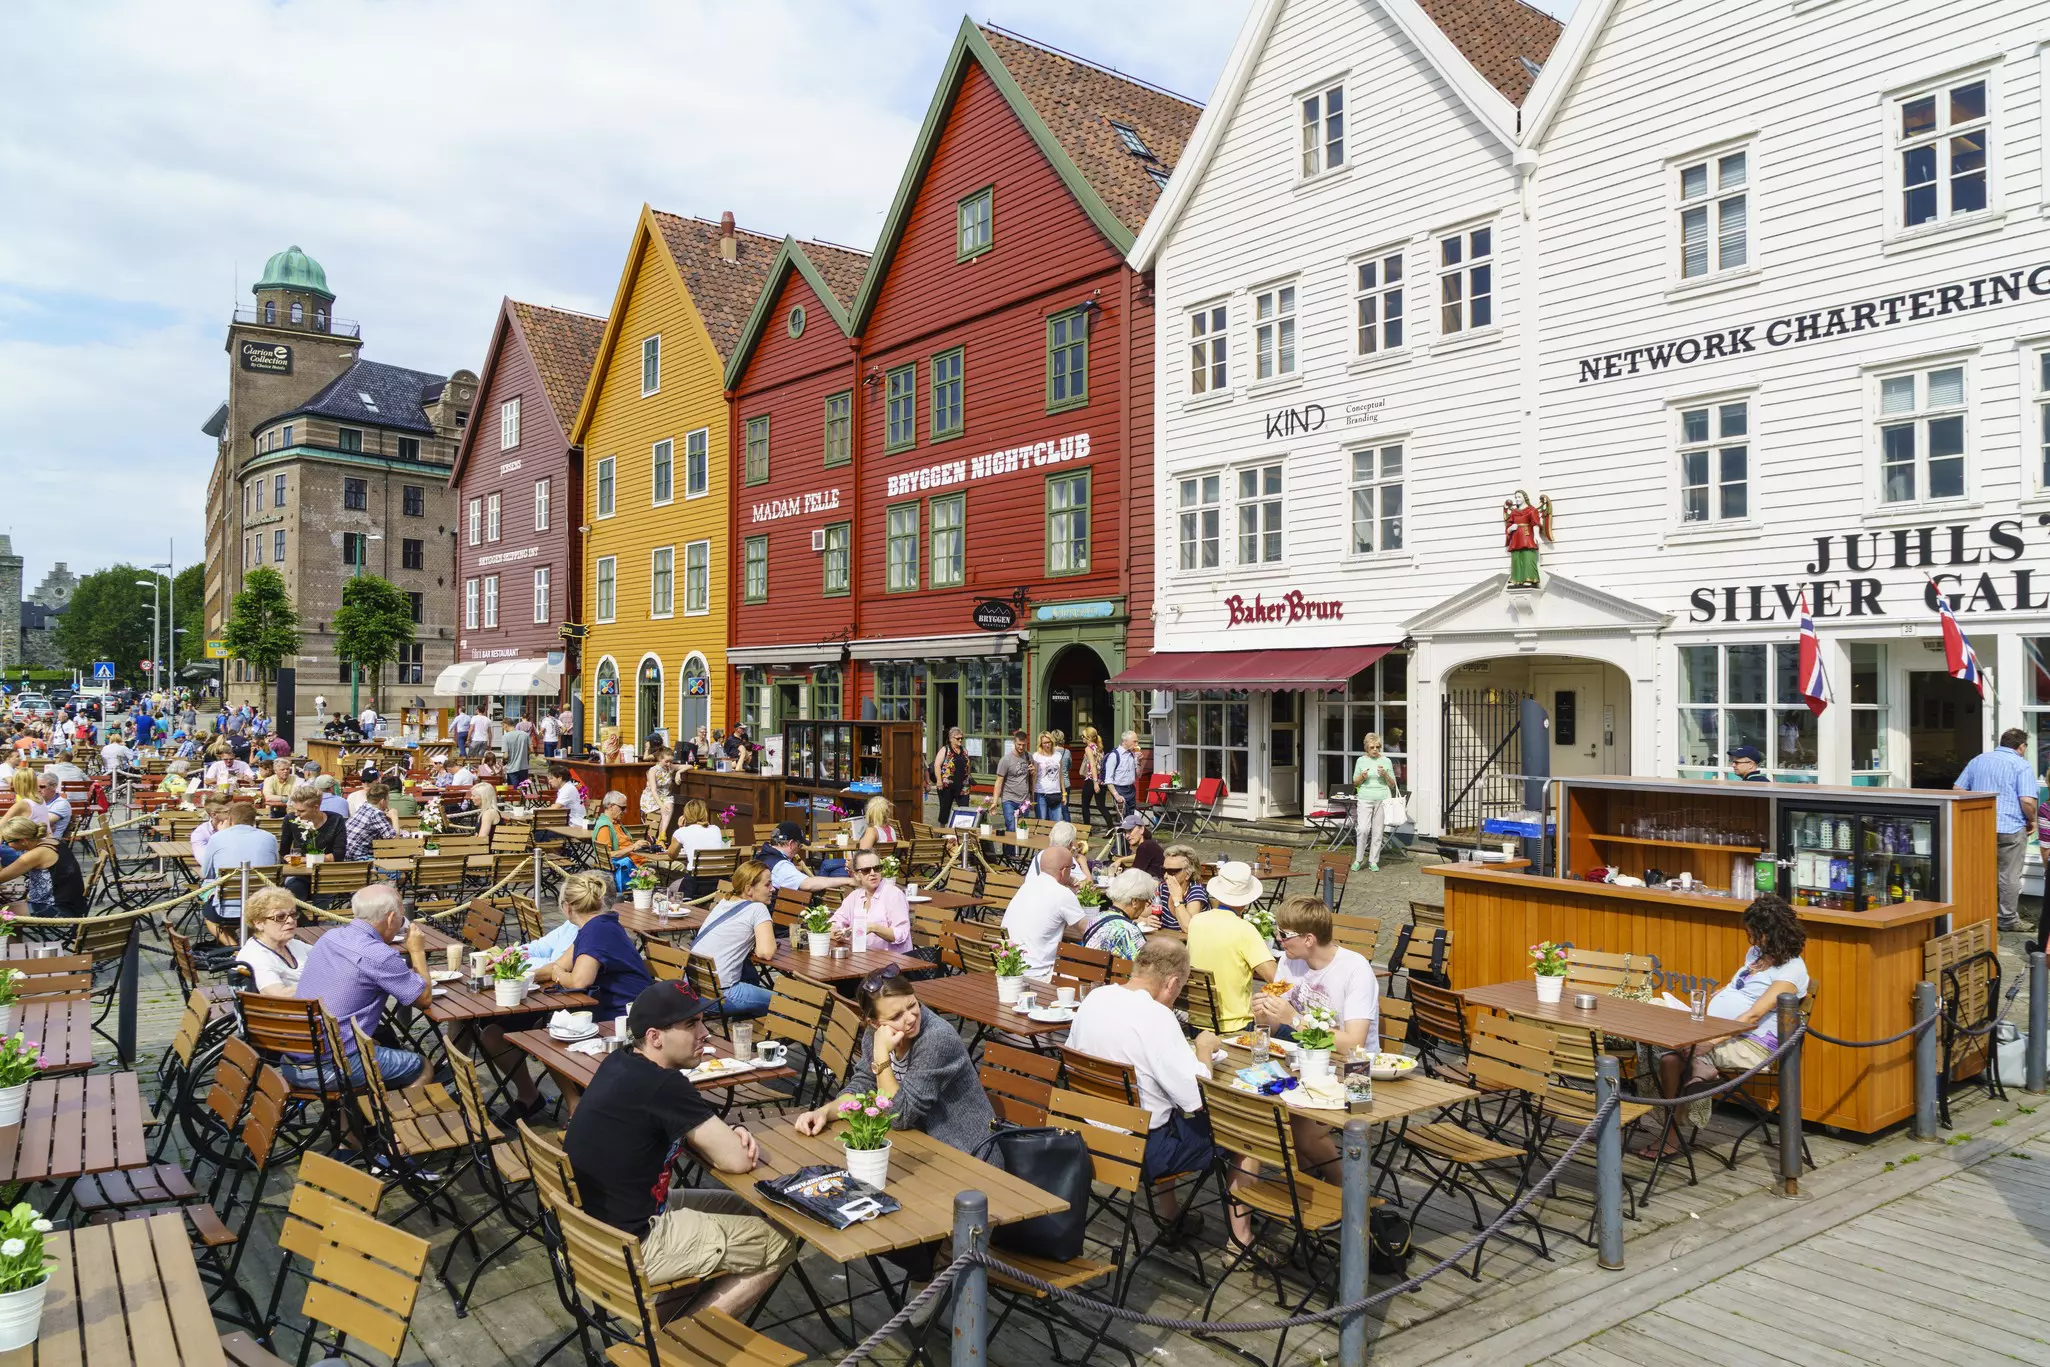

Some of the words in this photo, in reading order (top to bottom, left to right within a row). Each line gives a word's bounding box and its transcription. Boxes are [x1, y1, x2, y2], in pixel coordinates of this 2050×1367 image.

[243, 344, 273, 357] Clarion
[1579, 326, 1756, 383] NETWORK
[250, 355, 288, 366] Collection
[1346, 398, 1386, 413] Conceptual
[1266, 404, 1325, 439] KIND
[1346, 412, 1378, 425] Branding
[887, 460, 966, 497] BRYGGEN
[971, 433, 1091, 479] NIGHTCLUB
[752, 496, 800, 523] MADAM
[804, 488, 840, 514] FELLE
[479, 553, 502, 566] BRYGGEN
[503, 549, 527, 562] SHIPPING
[1690, 577, 1887, 623] SILVER
[1924, 568, 2049, 613] GAL
[1224, 593, 1286, 630] Baker
[1282, 589, 1344, 626] Brun
[978, 615, 1011, 624] BRYGGEN
[482, 650, 491, 659] BAR
[491, 648, 519, 658] RESTAURANT
